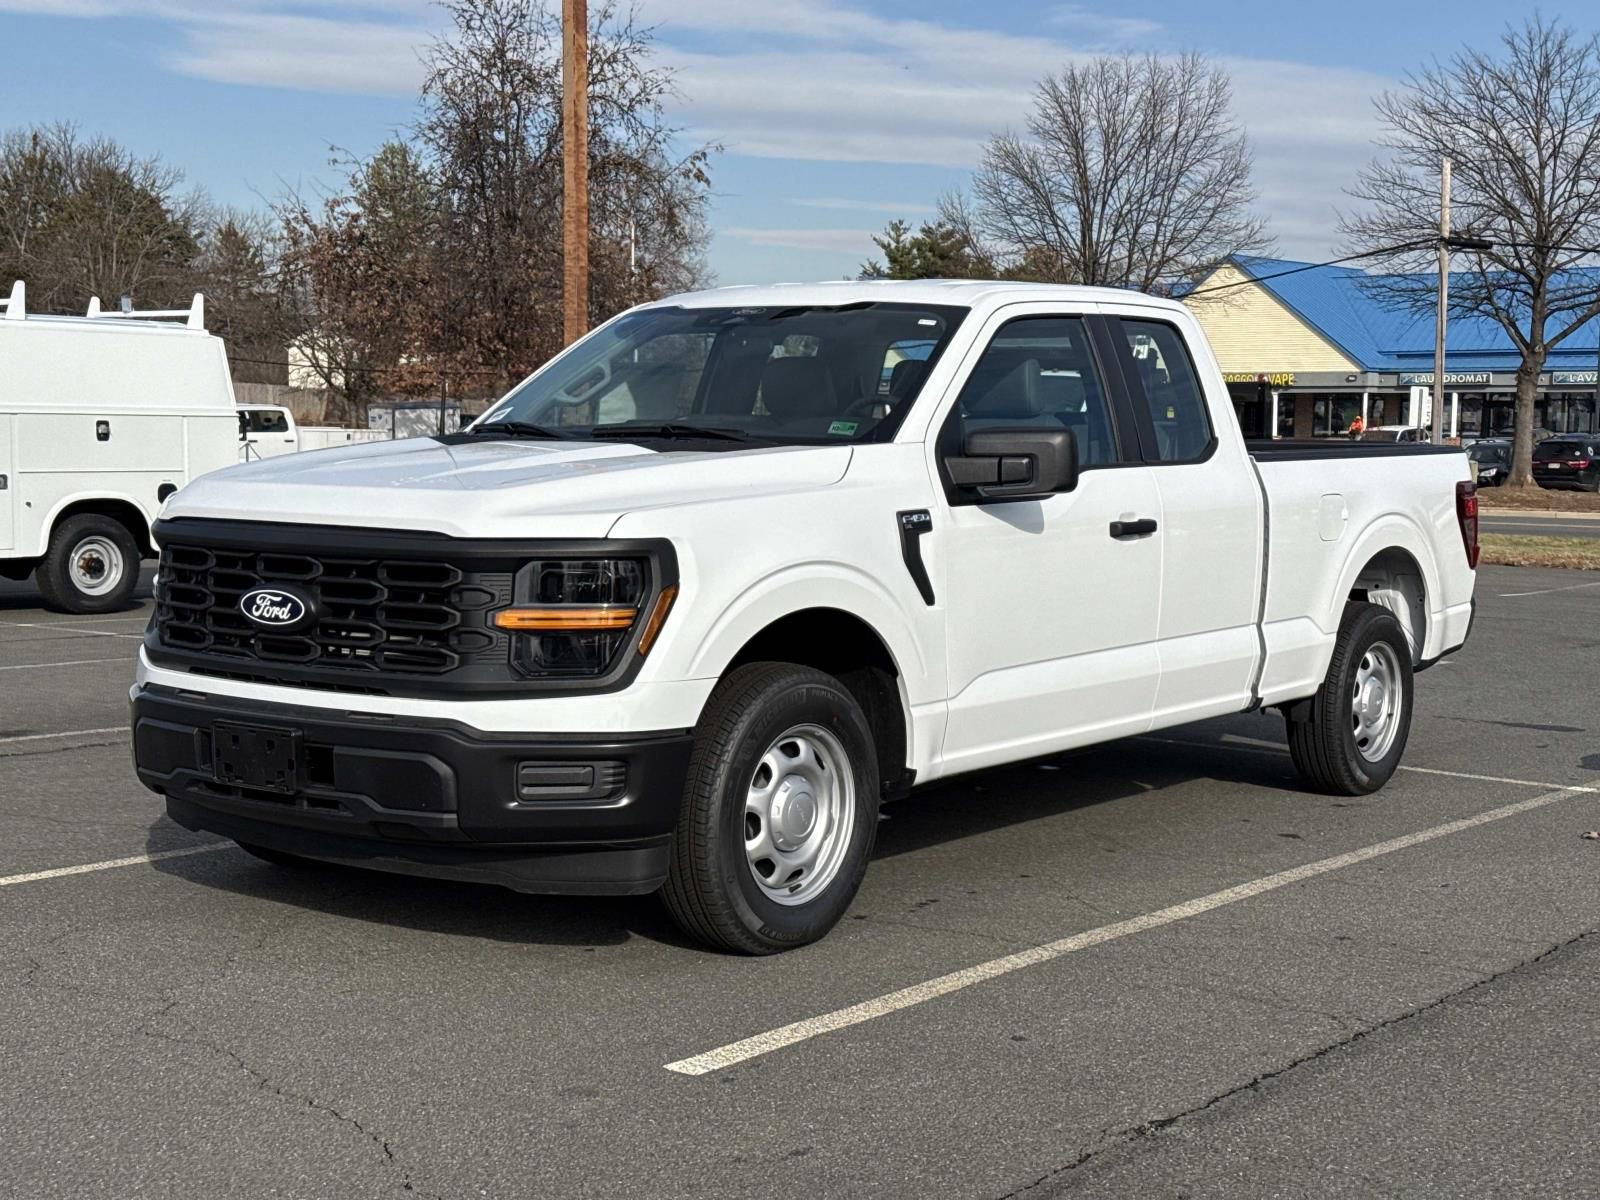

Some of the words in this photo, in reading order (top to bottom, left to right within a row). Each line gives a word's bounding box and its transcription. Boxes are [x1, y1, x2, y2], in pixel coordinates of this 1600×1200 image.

[1268, 373, 1295, 385] VAPE
[1415, 374, 1488, 383] LAUDROMAT
[252, 594, 292, 620] Ford
